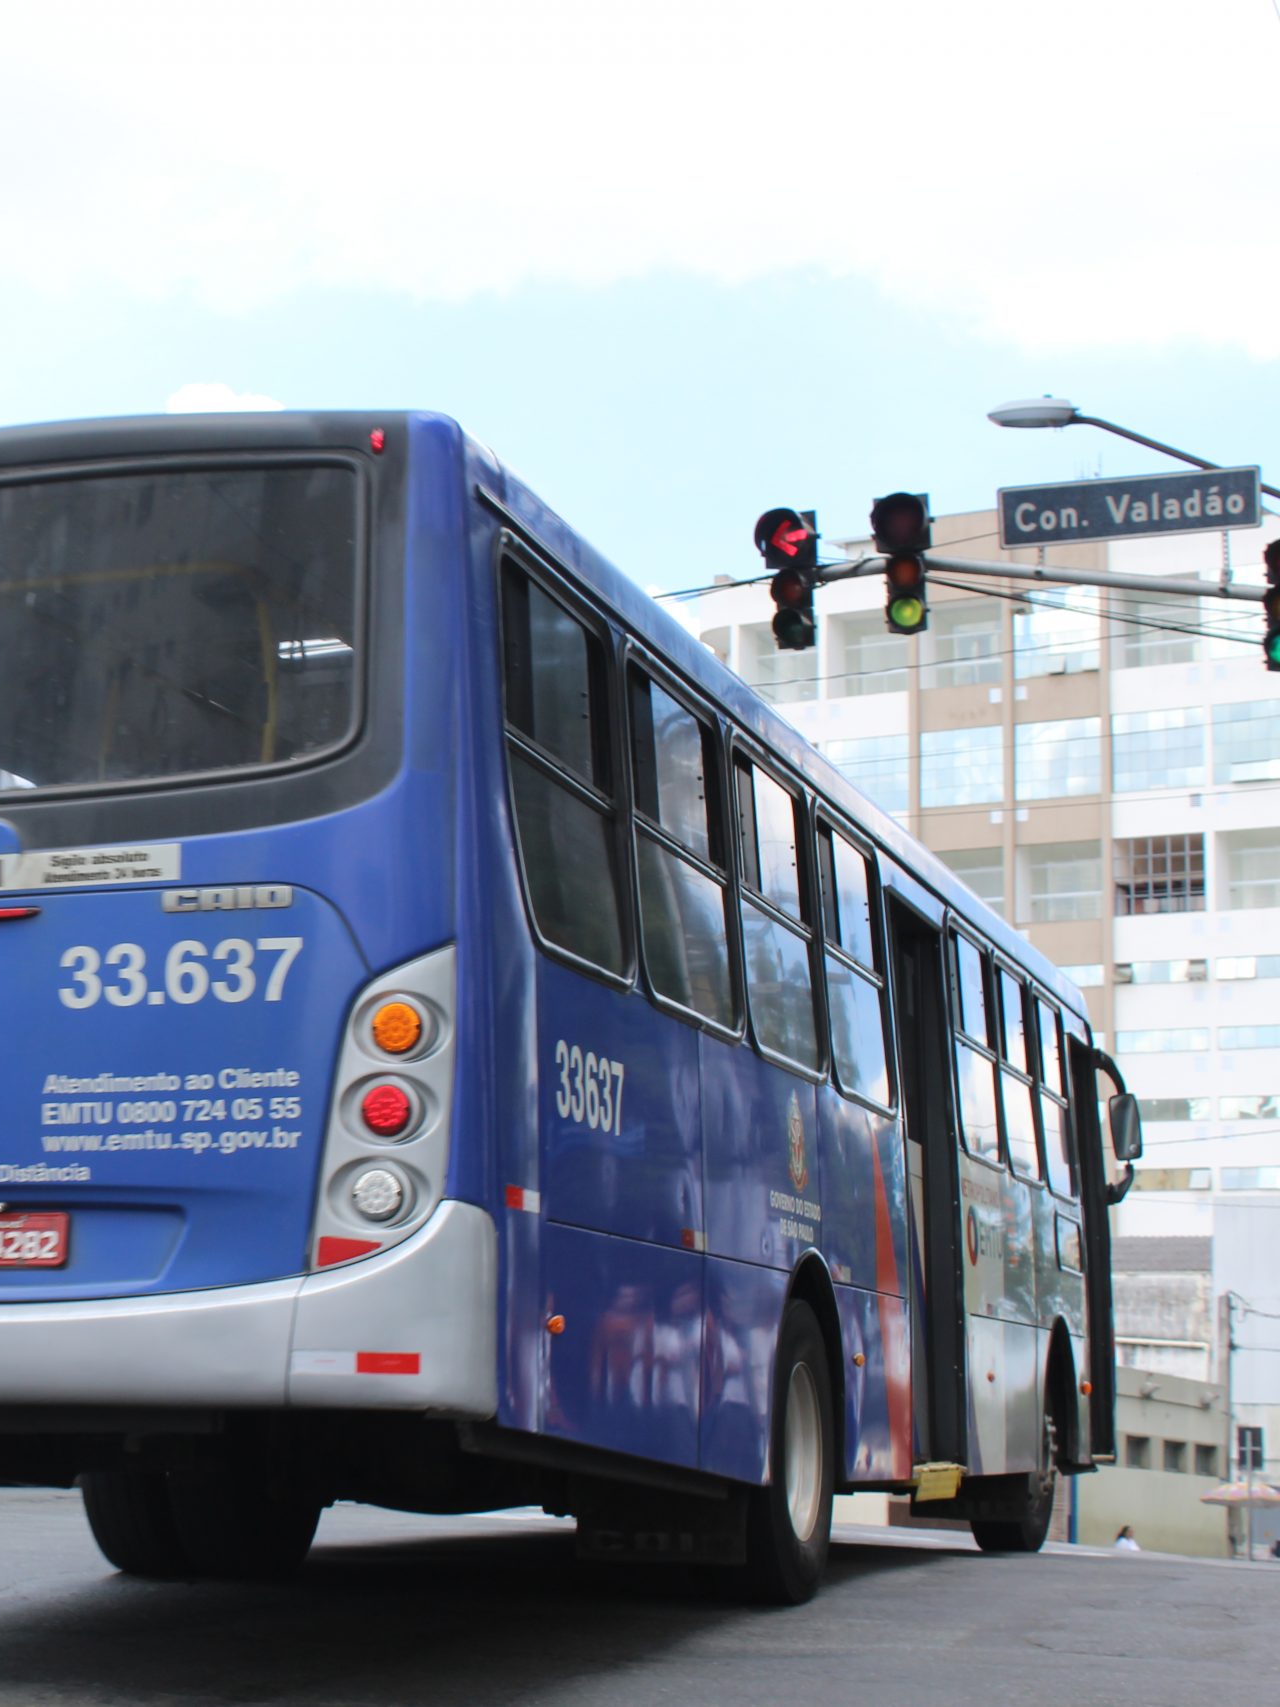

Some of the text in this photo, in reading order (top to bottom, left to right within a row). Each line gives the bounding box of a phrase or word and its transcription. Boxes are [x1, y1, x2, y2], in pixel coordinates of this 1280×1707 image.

[1014, 502, 1089, 532] Con.
[162, 885, 292, 912] CAIO
[58, 937, 304, 1009] 33.637
[42, 1067, 300, 1094] Atendimento ao Cliente
[555, 1039, 624, 1136] 33637
[41, 1097, 301, 1125] EMTU 0800 724 05 55
[41, 1126, 301, 1153] www.emtu.sp.gov.br
